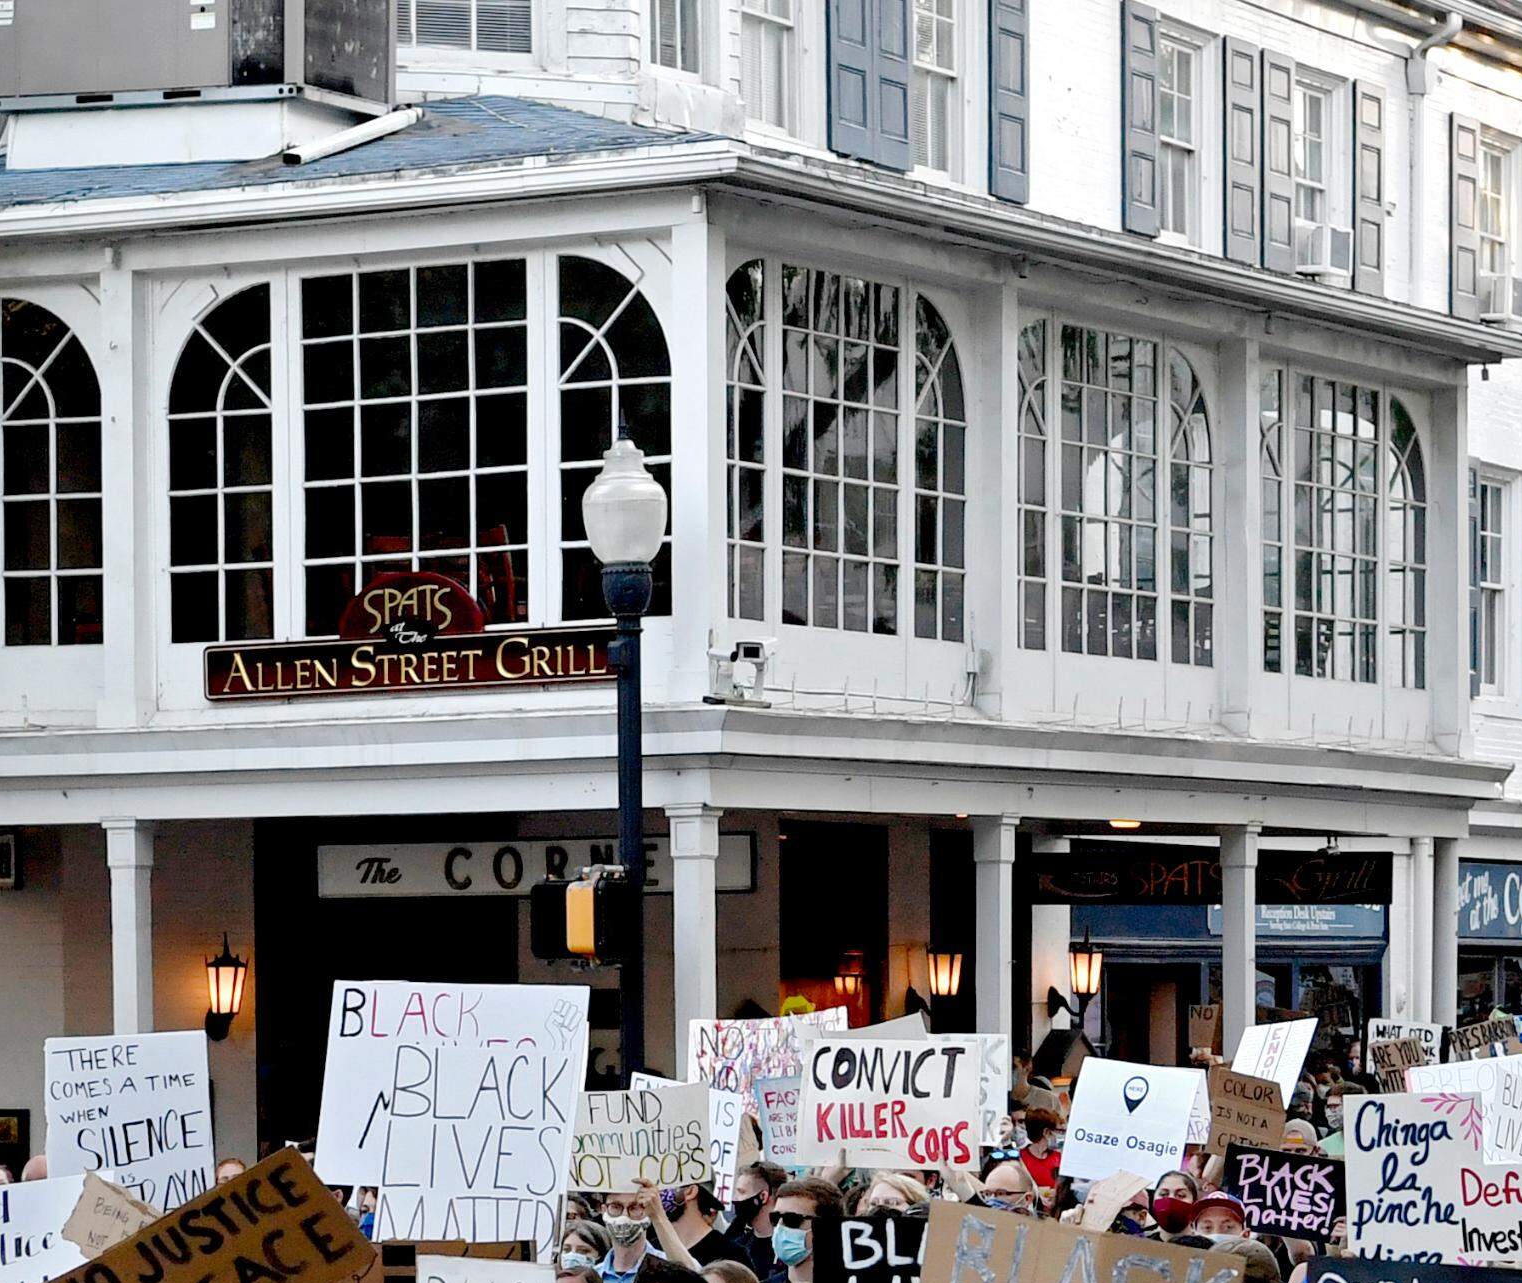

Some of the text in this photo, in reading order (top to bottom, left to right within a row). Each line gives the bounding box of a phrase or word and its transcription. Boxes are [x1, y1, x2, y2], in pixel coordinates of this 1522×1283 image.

[363, 585, 452, 632] SPATS
[223, 637, 610, 692] ALLEN STREET GRILL
[340, 988, 482, 1037] BLACK
[1190, 1006, 1213, 1021] NO
[52, 1044, 139, 1071] THERE
[812, 1045, 966, 1099] CONVICT
[50, 1073, 196, 1101] COMES A TIME
[390, 1045, 568, 1123] BLACK
[1223, 1079, 1275, 1104] COLOR
[60, 1105, 109, 1124] WHEN
[588, 1091, 662, 1125] FUND
[715, 1101, 735, 1128] IS
[816, 1100, 909, 1143] KILLER
[1216, 1106, 1270, 1130] IS NOT A
[77, 1110, 204, 1171] SILENCE
[908, 1120, 970, 1164] COPS
[1074, 1128, 1178, 1157] Osaze Osagie
[1355, 1100, 1453, 1166] Chinga
[382, 1119, 561, 1197] LIVES
[1236, 1153, 1335, 1193] BLACK
[1352, 1186, 1459, 1240] pinche
